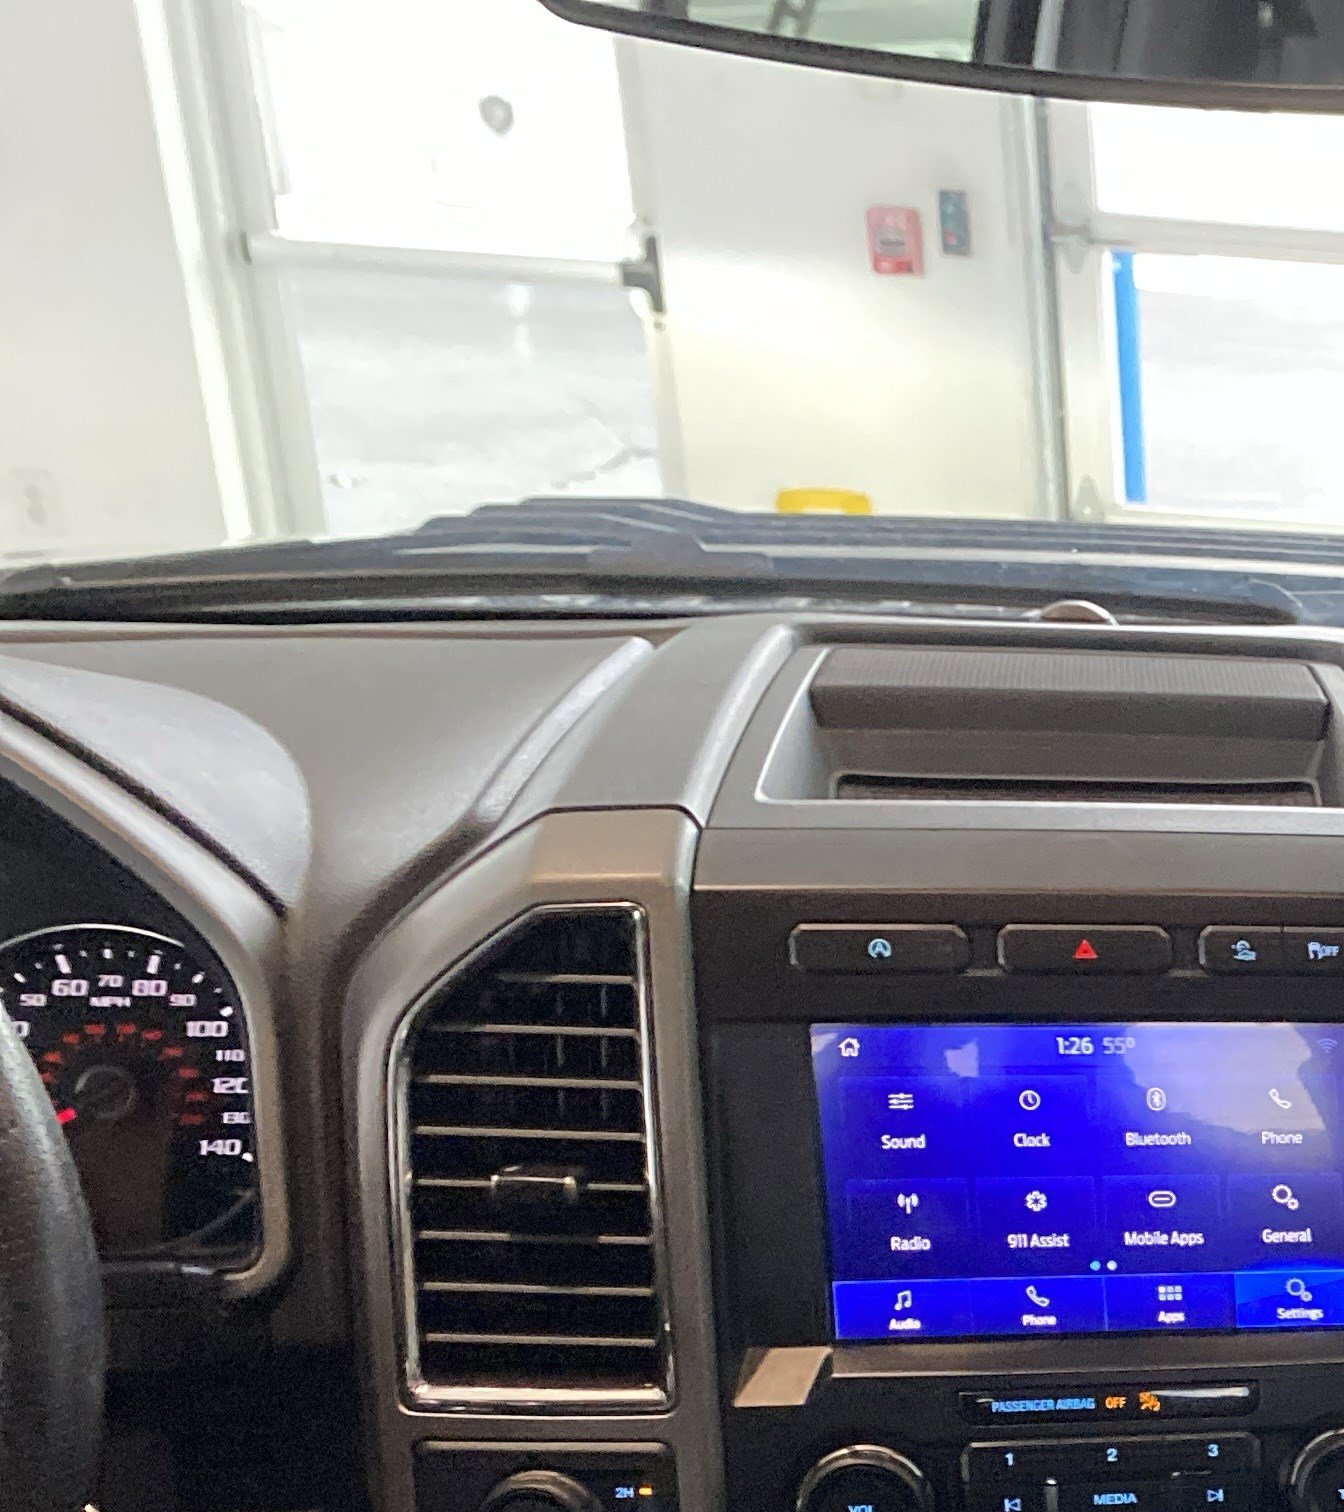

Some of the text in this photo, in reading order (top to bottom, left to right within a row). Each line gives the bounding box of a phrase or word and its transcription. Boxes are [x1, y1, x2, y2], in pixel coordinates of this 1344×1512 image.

[51, 979, 89, 997] 60
[98, 974, 124, 988] 70
[132, 979, 168, 997] 80
[168, 993, 197, 1007] 90
[11, 1020, 31, 1038] 0
[186, 1020, 229, 1038] 100
[1056, 1036, 1095, 1056] 1:26
[215, 1049, 246, 1062] 110
[881, 1133, 927, 1150] Sound
[1013, 1133, 1051, 1148] Clock
[1125, 1131, 1192, 1147] Bluetooth
[1261, 1130, 1304, 1145] Phone
[199, 1139, 243, 1156] 140
[890, 1235, 932, 1251] Radio
[1006, 1233, 1071, 1249] 911 Assist
[1124, 1230, 1205, 1247] Mobile Apps
[1261, 1228, 1313, 1244] General
[1021, 1313, 1057, 1327] Phone
[1157, 1310, 1186, 1324] Apps
[1276, 1306, 1325, 1321] Settings
[888, 1317, 922, 1331] Audio
[991, 1395, 1127, 1413] PASSENGER AIRBAG OFF
[1106, 1447, 1118, 1463] 2
[1207, 1443, 1219, 1458] 3
[1004, 1452, 1015, 1467] 1
[614, 1486, 636, 1499] 2H
[1092, 1491, 1139, 1506] MEDIA
